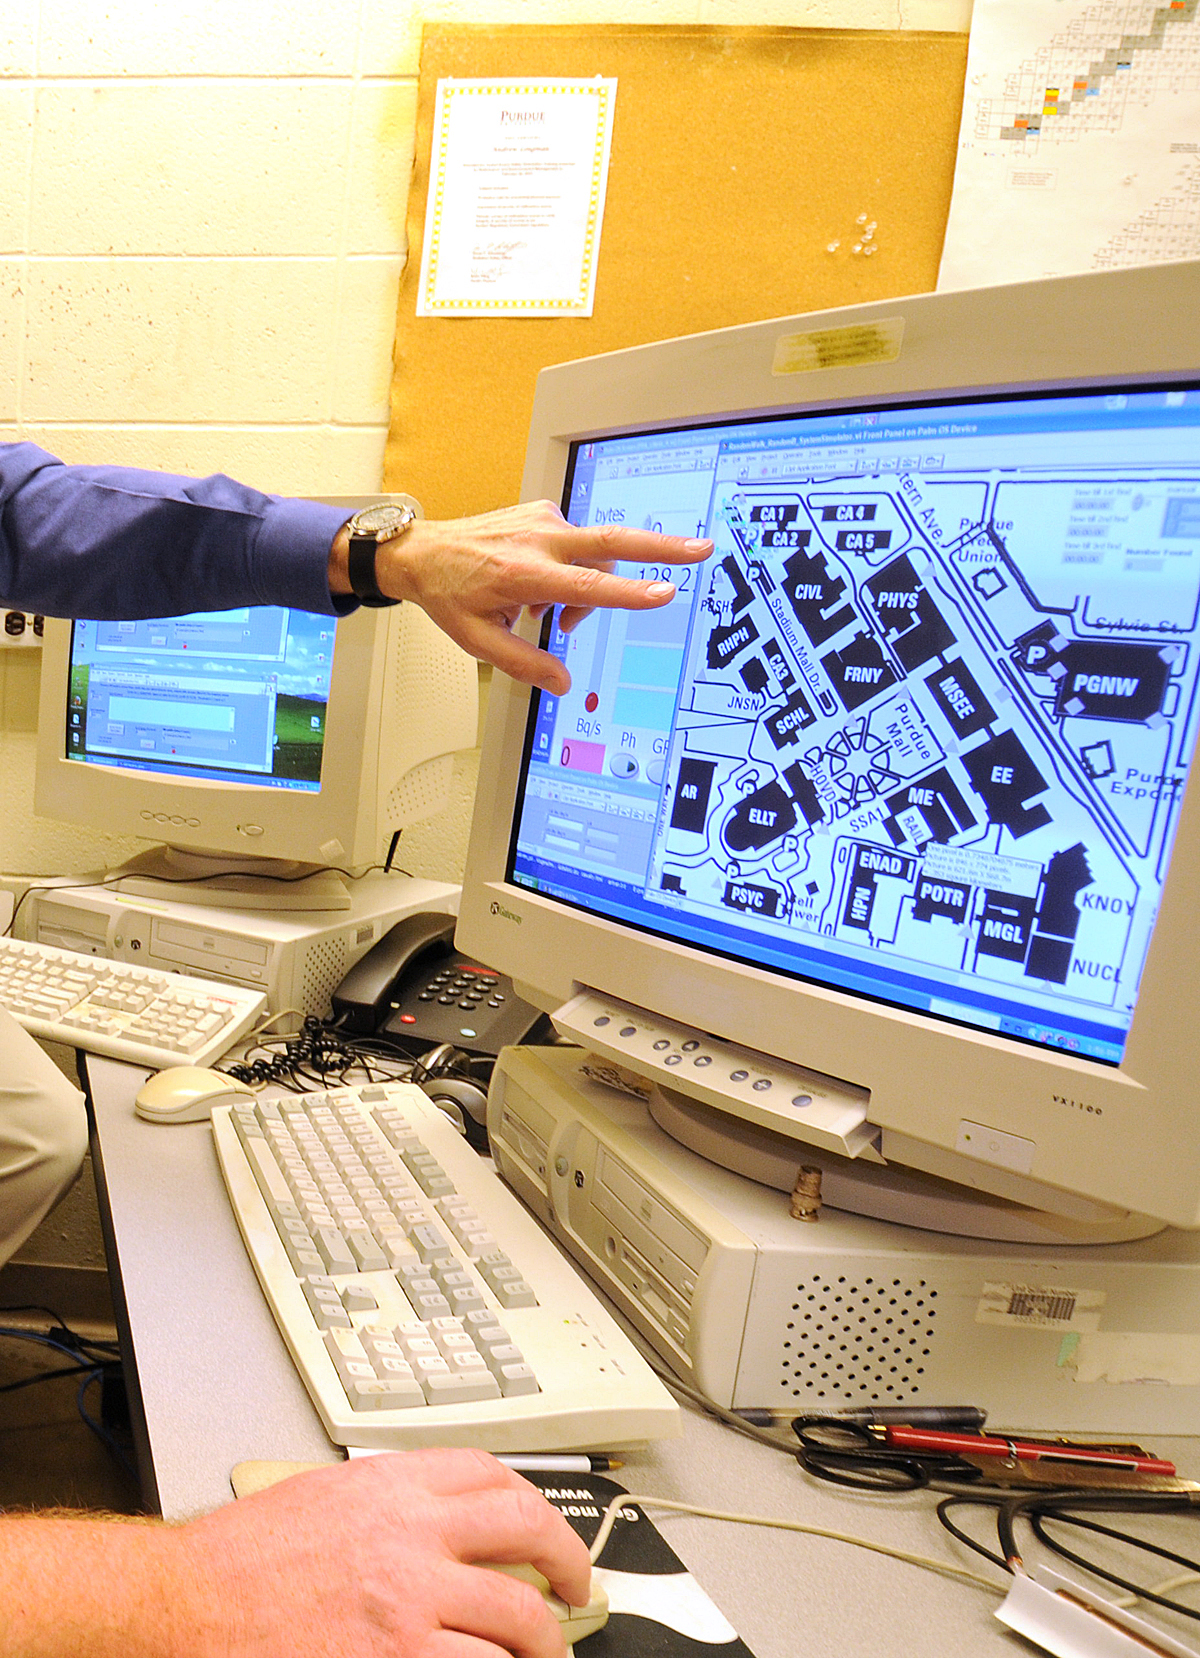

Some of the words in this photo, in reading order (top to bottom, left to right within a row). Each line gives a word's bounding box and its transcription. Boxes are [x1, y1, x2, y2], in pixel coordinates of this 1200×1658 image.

[501, 110, 545, 121] PURDUE
[595, 508, 626, 523] bytes
[960, 518, 1013, 530] Purue
[920, 508, 943, 546] Ave.
[958, 550, 1003, 563] Union
[794, 584, 824, 600] CIVL
[877, 591, 919, 609] PHYS
[717, 626, 750, 657] RHPH
[771, 598, 799, 647] Stadium
[795, 646, 815, 672] Mall
[808, 672, 822, 691] Dr.
[1026, 645, 1047, 665] P
[844, 666, 883, 684] FRNY
[1073, 673, 1140, 697] PGNW
[727, 696, 760, 711] JNSN
[938, 675, 975, 720] MSEE
[576, 717, 602, 737] Bq/s
[775, 706, 810, 735] SCHL
[620, 732, 637, 748] Ph
[886, 722, 913, 758] Mall
[894, 703, 931, 760] Purdue
[561, 746, 571, 766] 0
[810, 765, 837, 802] HOVD
[991, 765, 1014, 785] EE
[681, 783, 699, 800] AR
[908, 786, 935, 806] ME
[748, 808, 778, 827] ELLT
[903, 815, 925, 844] RAIL
[859, 851, 903, 874] ENAD
[731, 885, 764, 908] PSYC
[850, 886, 872, 921] HPN
[920, 882, 965, 907] POTR
[1082, 892, 1136, 916] KNOY
[983, 919, 1023, 944] MGL
[1072, 958, 1122, 984] NUCL
[1053, 1094, 1102, 1115] VX1100
[555, 1505, 600, 1517] mor
